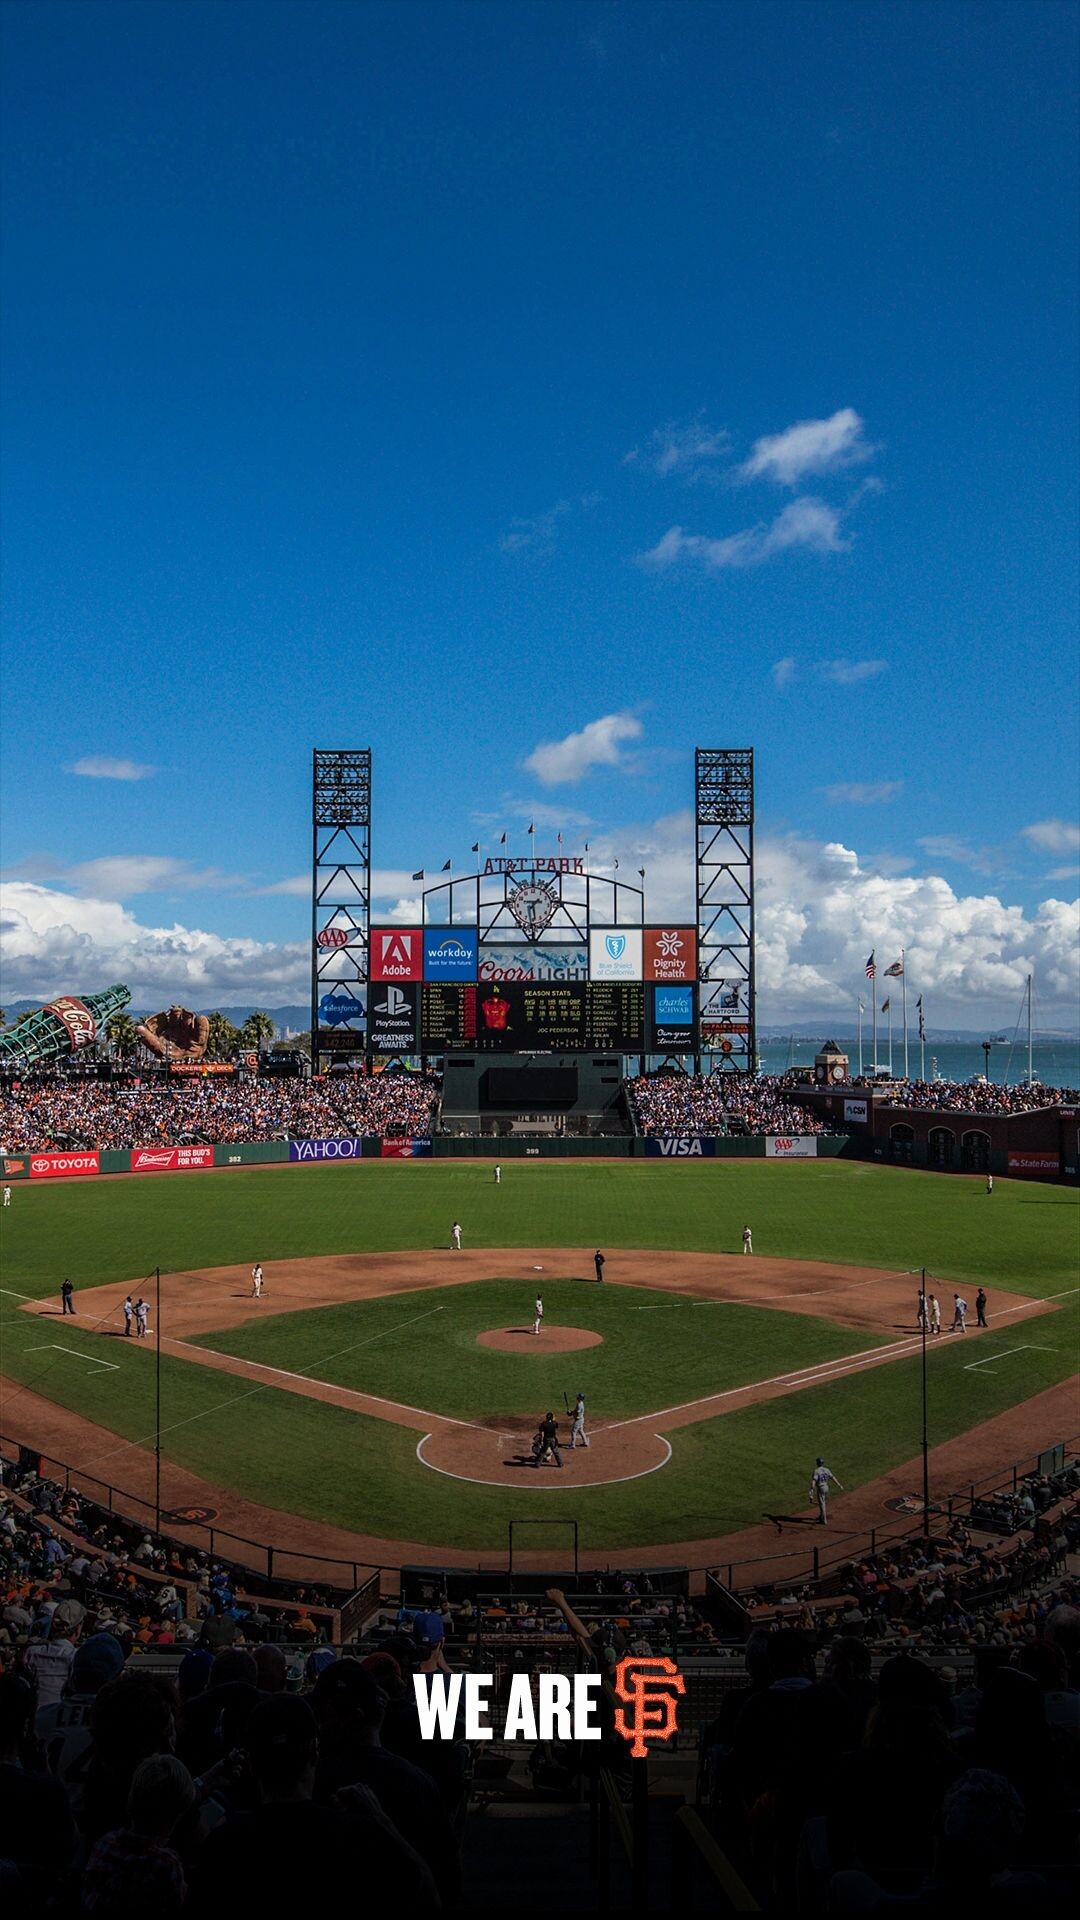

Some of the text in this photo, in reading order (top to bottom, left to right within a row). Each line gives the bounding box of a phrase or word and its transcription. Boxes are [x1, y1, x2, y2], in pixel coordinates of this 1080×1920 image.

[484, 858, 584, 874] AT&T PARK
[320, 930, 346, 946] AAA
[428, 948, 472, 959] workday
[654, 958, 686, 970] Dignity
[382, 966, 411, 976] Adobe
[478, 960, 588, 981] Coors LIGHT
[656, 970, 685, 978] Health
[658, 996, 688, 1006] charles
[324, 1004, 358, 1014] salesforce
[376, 1020, 410, 1028] PlayStation
[853, 1106, 866, 1115] CSN
[294, 1139, 358, 1160] YAHOO!
[655, 1138, 703, 1155] VISA
[775, 1138, 792, 1150] AAA
[51, 1158, 97, 1169] TOYOTA
